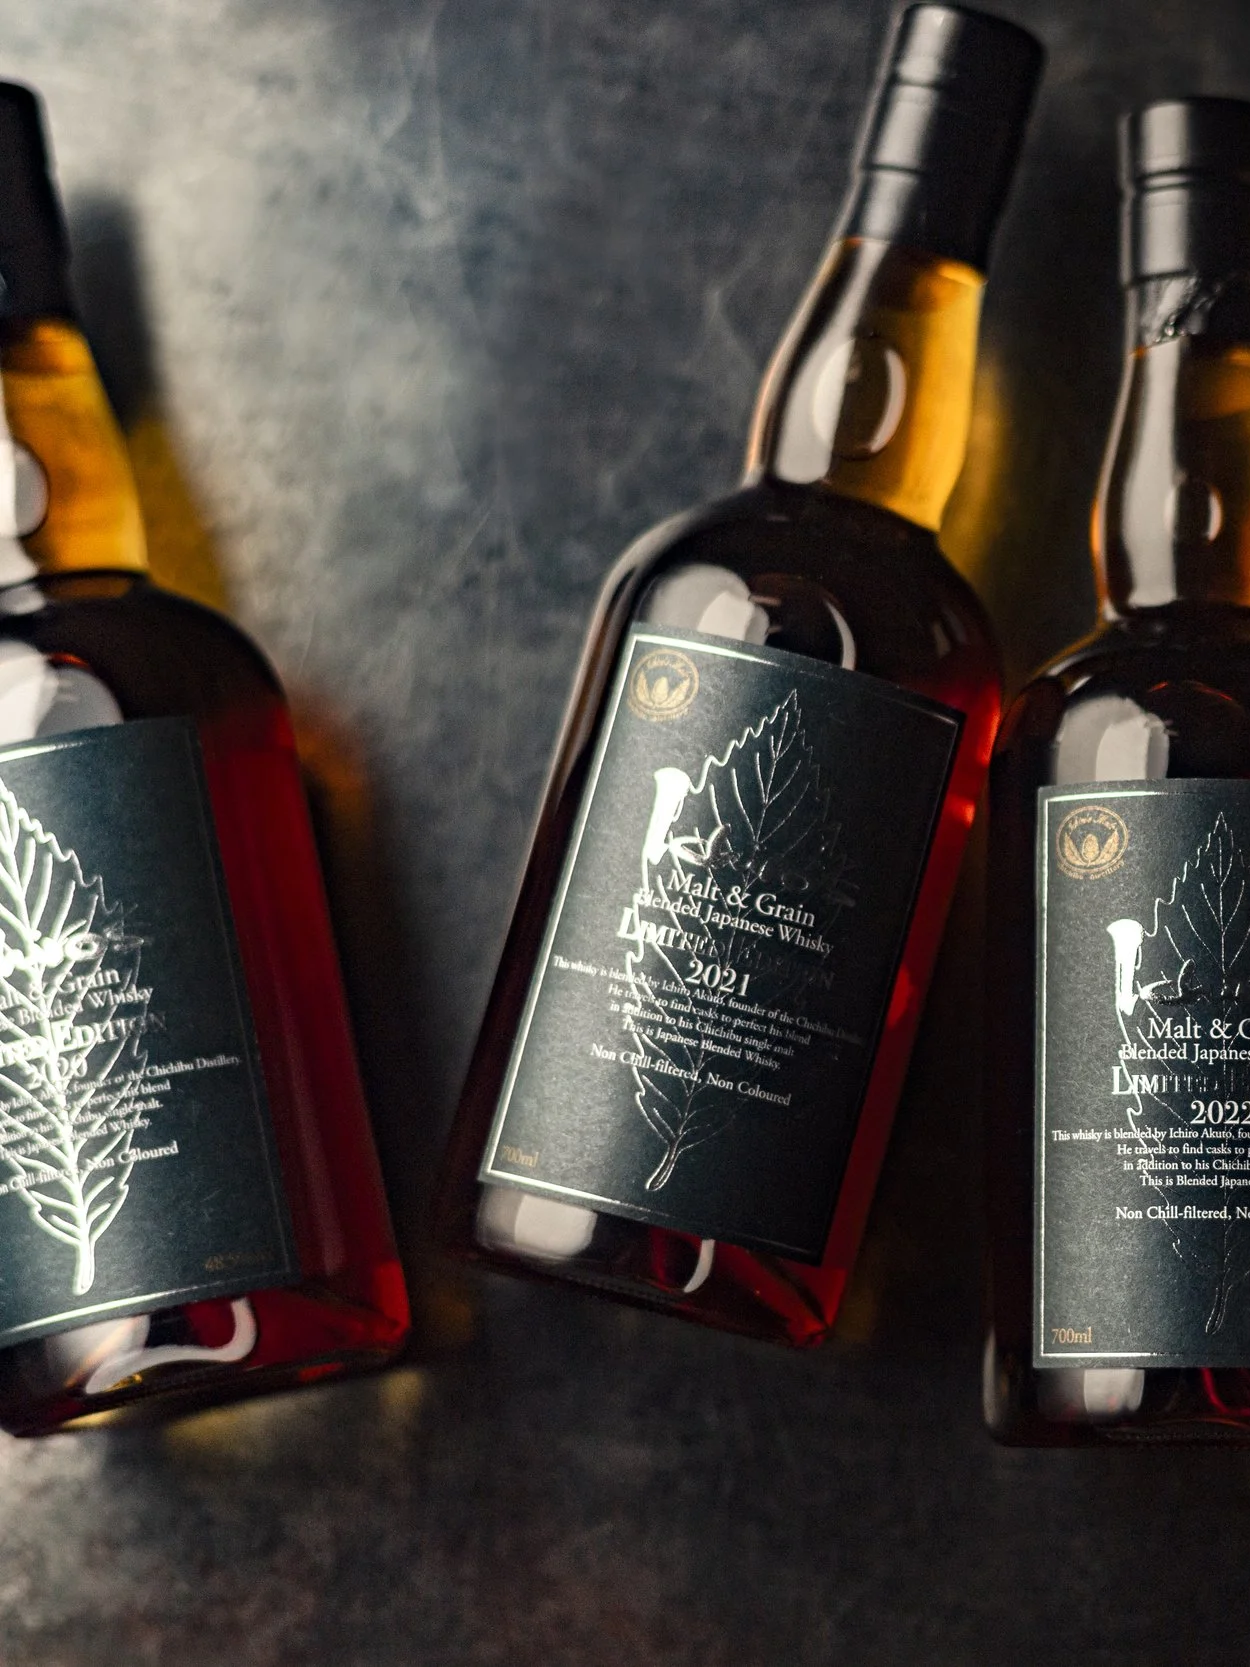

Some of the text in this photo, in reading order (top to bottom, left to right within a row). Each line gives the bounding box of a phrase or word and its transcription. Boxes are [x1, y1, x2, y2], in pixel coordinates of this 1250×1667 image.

[667, 867, 818, 926] Malt & Grain
[703, 905, 775, 941] Japanese
[776, 924, 835, 954] Whisky
[685, 958, 751, 996] 2021
[88, 983, 154, 1009] Whisky
[608, 983, 622, 995] He
[670, 999, 691, 1012] find
[721, 1014, 731, 1022] to
[769, 1025, 782, 1036] his
[728, 997, 765, 1016] founder
[768, 1008, 779, 1019] of
[780, 1011, 794, 1023] the
[610, 1001, 619, 1011] in
[679, 1017, 693, 1028] his
[744, 1034, 772, 1051] single
[646, 1025, 653, 1035] is
[656, 1027, 698, 1049] Japanese
[1147, 1016, 1201, 1039] Malt
[1209, 1018, 1232, 1039] &
[1121, 1042, 1187, 1059] Blended
[145, 1057, 194, 1078] Chichibu
[590, 1043, 616, 1060] Non
[706, 1072, 734, 1090] Non
[737, 1080, 791, 1105] Coloured
[140, 1078, 171, 1094] blend
[1051, 1129, 1070, 1141] This
[1072, 1128, 1102, 1141] whisky
[1104, 1128, 1111, 1138] is
[1113, 1127, 1151, 1138] blended
[1154, 1127, 1166, 1141] by
[1169, 1127, 1198, 1138] Ichiro
[1201, 1127, 1234, 1140] Akuto,
[1116, 1143, 1131, 1154] He
[1135, 1143, 1165, 1154] travels
[1168, 1145, 1179, 1153] to
[1182, 1142, 1202, 1154] find
[1206, 1143, 1231, 1154] casks
[1234, 1146, 1245, 1154] to
[1123, 1160, 1133, 1170] in
[1181, 1160, 1191, 1169] to
[1194, 1159, 1209, 1169] his
[1140, 1175, 1162, 1185] This
[1165, 1175, 1172, 1185] is
[1176, 1174, 1217, 1185] Blended
[1115, 1206, 1142, 1219] Non
[1146, 1205, 1232, 1220] Chill-filtered,
[1051, 1325, 1093, 1345] 700ml
